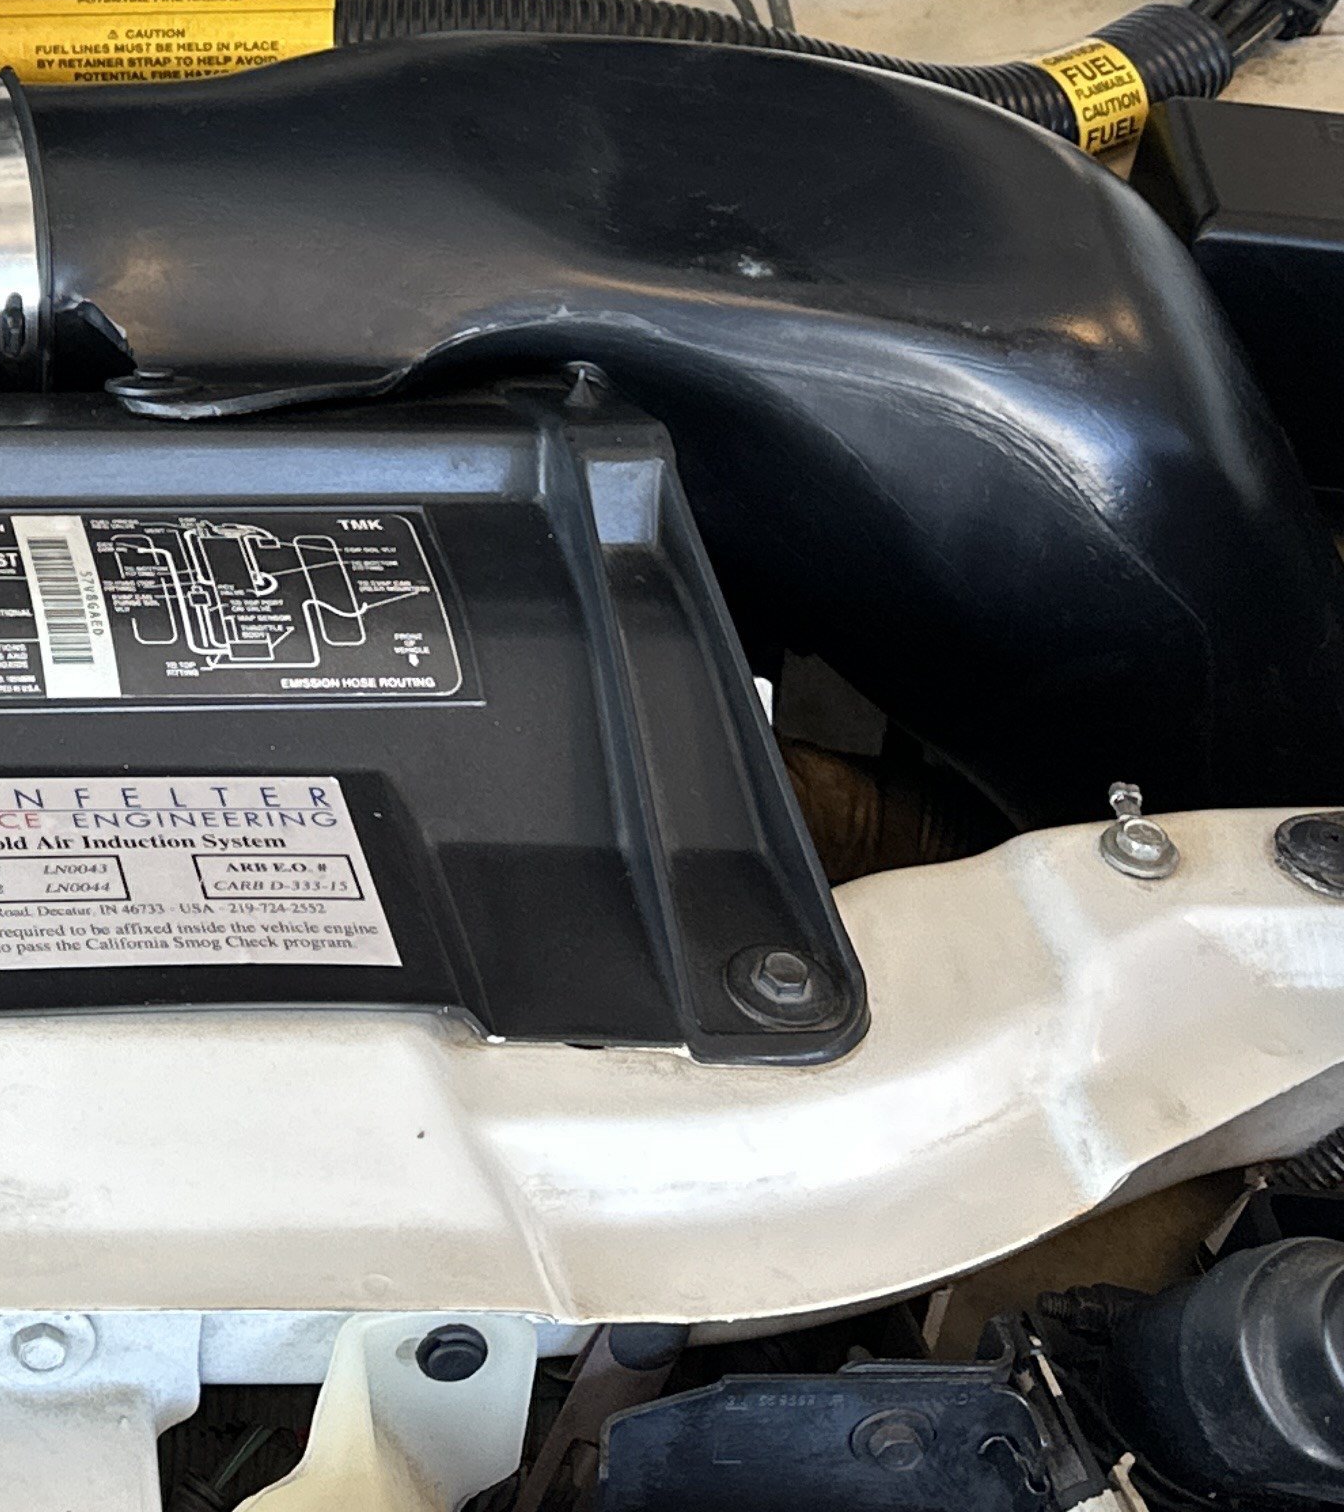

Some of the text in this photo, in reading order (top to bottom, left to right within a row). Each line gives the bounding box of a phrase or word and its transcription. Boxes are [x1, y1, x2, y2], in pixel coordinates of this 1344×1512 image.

[125, 28, 186, 39] CAUTION
[35, 40, 280, 55] FUEL LINES MUST BE HELD IN PLACE
[37, 55, 279, 69] BY RETAINER STRAP TO HELP AVOID
[74, 71, 147, 82] POTENTIAL
[150, 70, 181, 81] FIRE
[1059, 54, 1127, 87] FUEL
[1074, 70, 1136, 101] FLAMMABLE
[1082, 89, 1141, 122] CAUTION
[1085, 115, 1140, 150] FUEL
[337, 519, 384, 531] TMK
[280, 676, 436, 689] EMISSION HOSE ROUTING
[72, 812, 339, 829] ENGINEERING
[37, 835, 73, 850] Air
[82, 835, 196, 849] Induction
[201, 834, 287, 851] System
[43, 864, 108, 876] LN0043
[225, 862, 268, 874] ARB
[316, 862, 329, 873] #
[44, 881, 111, 894] LN0044
[213, 879, 349, 893] CARB D-333-15
[69, 925, 85, 936] to
[90, 922, 111, 936] be
[115, 922, 173, 936] affixed
[176, 922, 226, 935] inside
[230, 922, 256, 934] the
[261, 921, 320, 934] vehicle
[323, 924, 379, 938] engine
[16, 942, 51, 956] pass
[55, 940, 81, 953] the
[85, 938, 170, 951] California
[174, 937, 223, 951] Smog
[225, 936, 280, 949] Check
